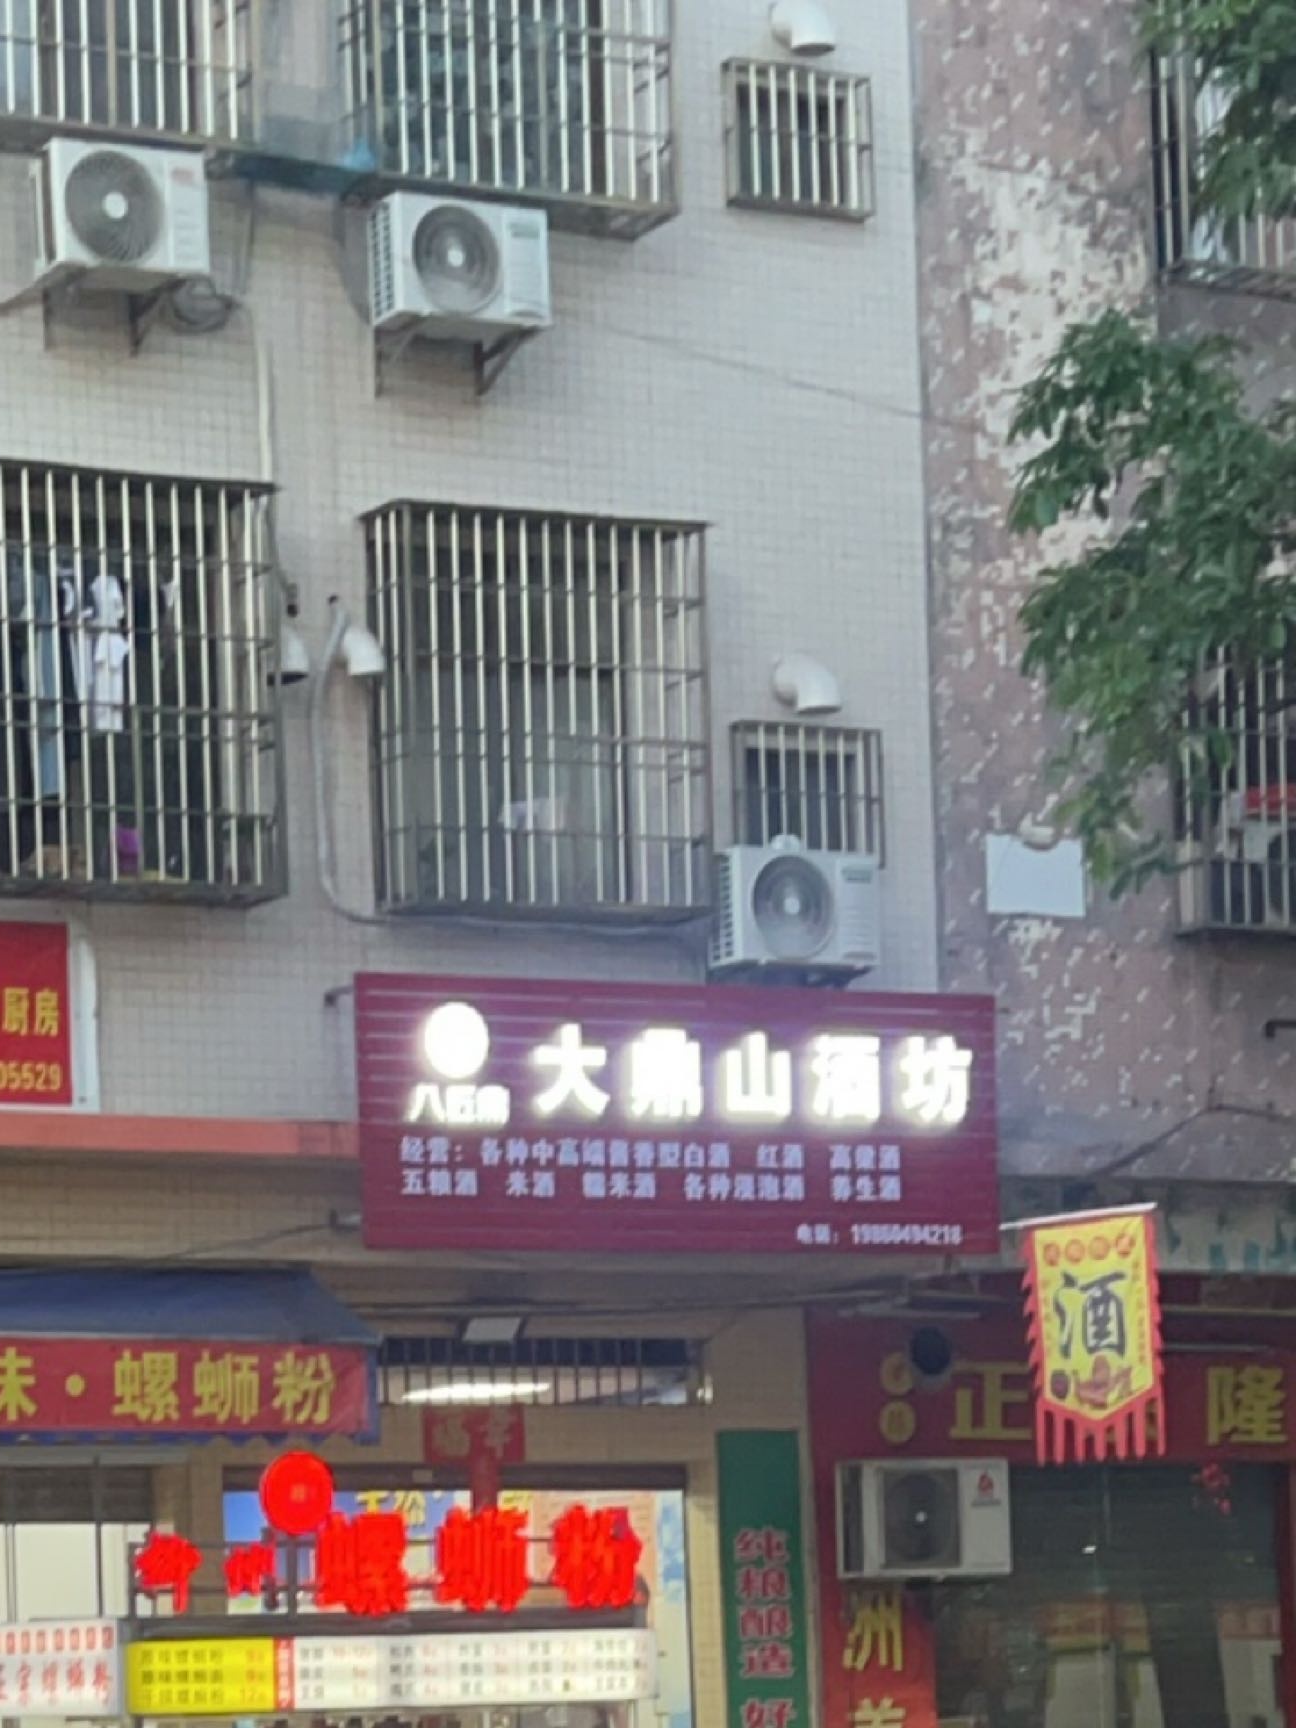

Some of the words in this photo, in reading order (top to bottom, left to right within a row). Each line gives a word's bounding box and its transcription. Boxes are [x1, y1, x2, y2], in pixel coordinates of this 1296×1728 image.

[1054, 1269, 1127, 1361] 酒
[734, 1526, 794, 1680] 纯粮酿造
